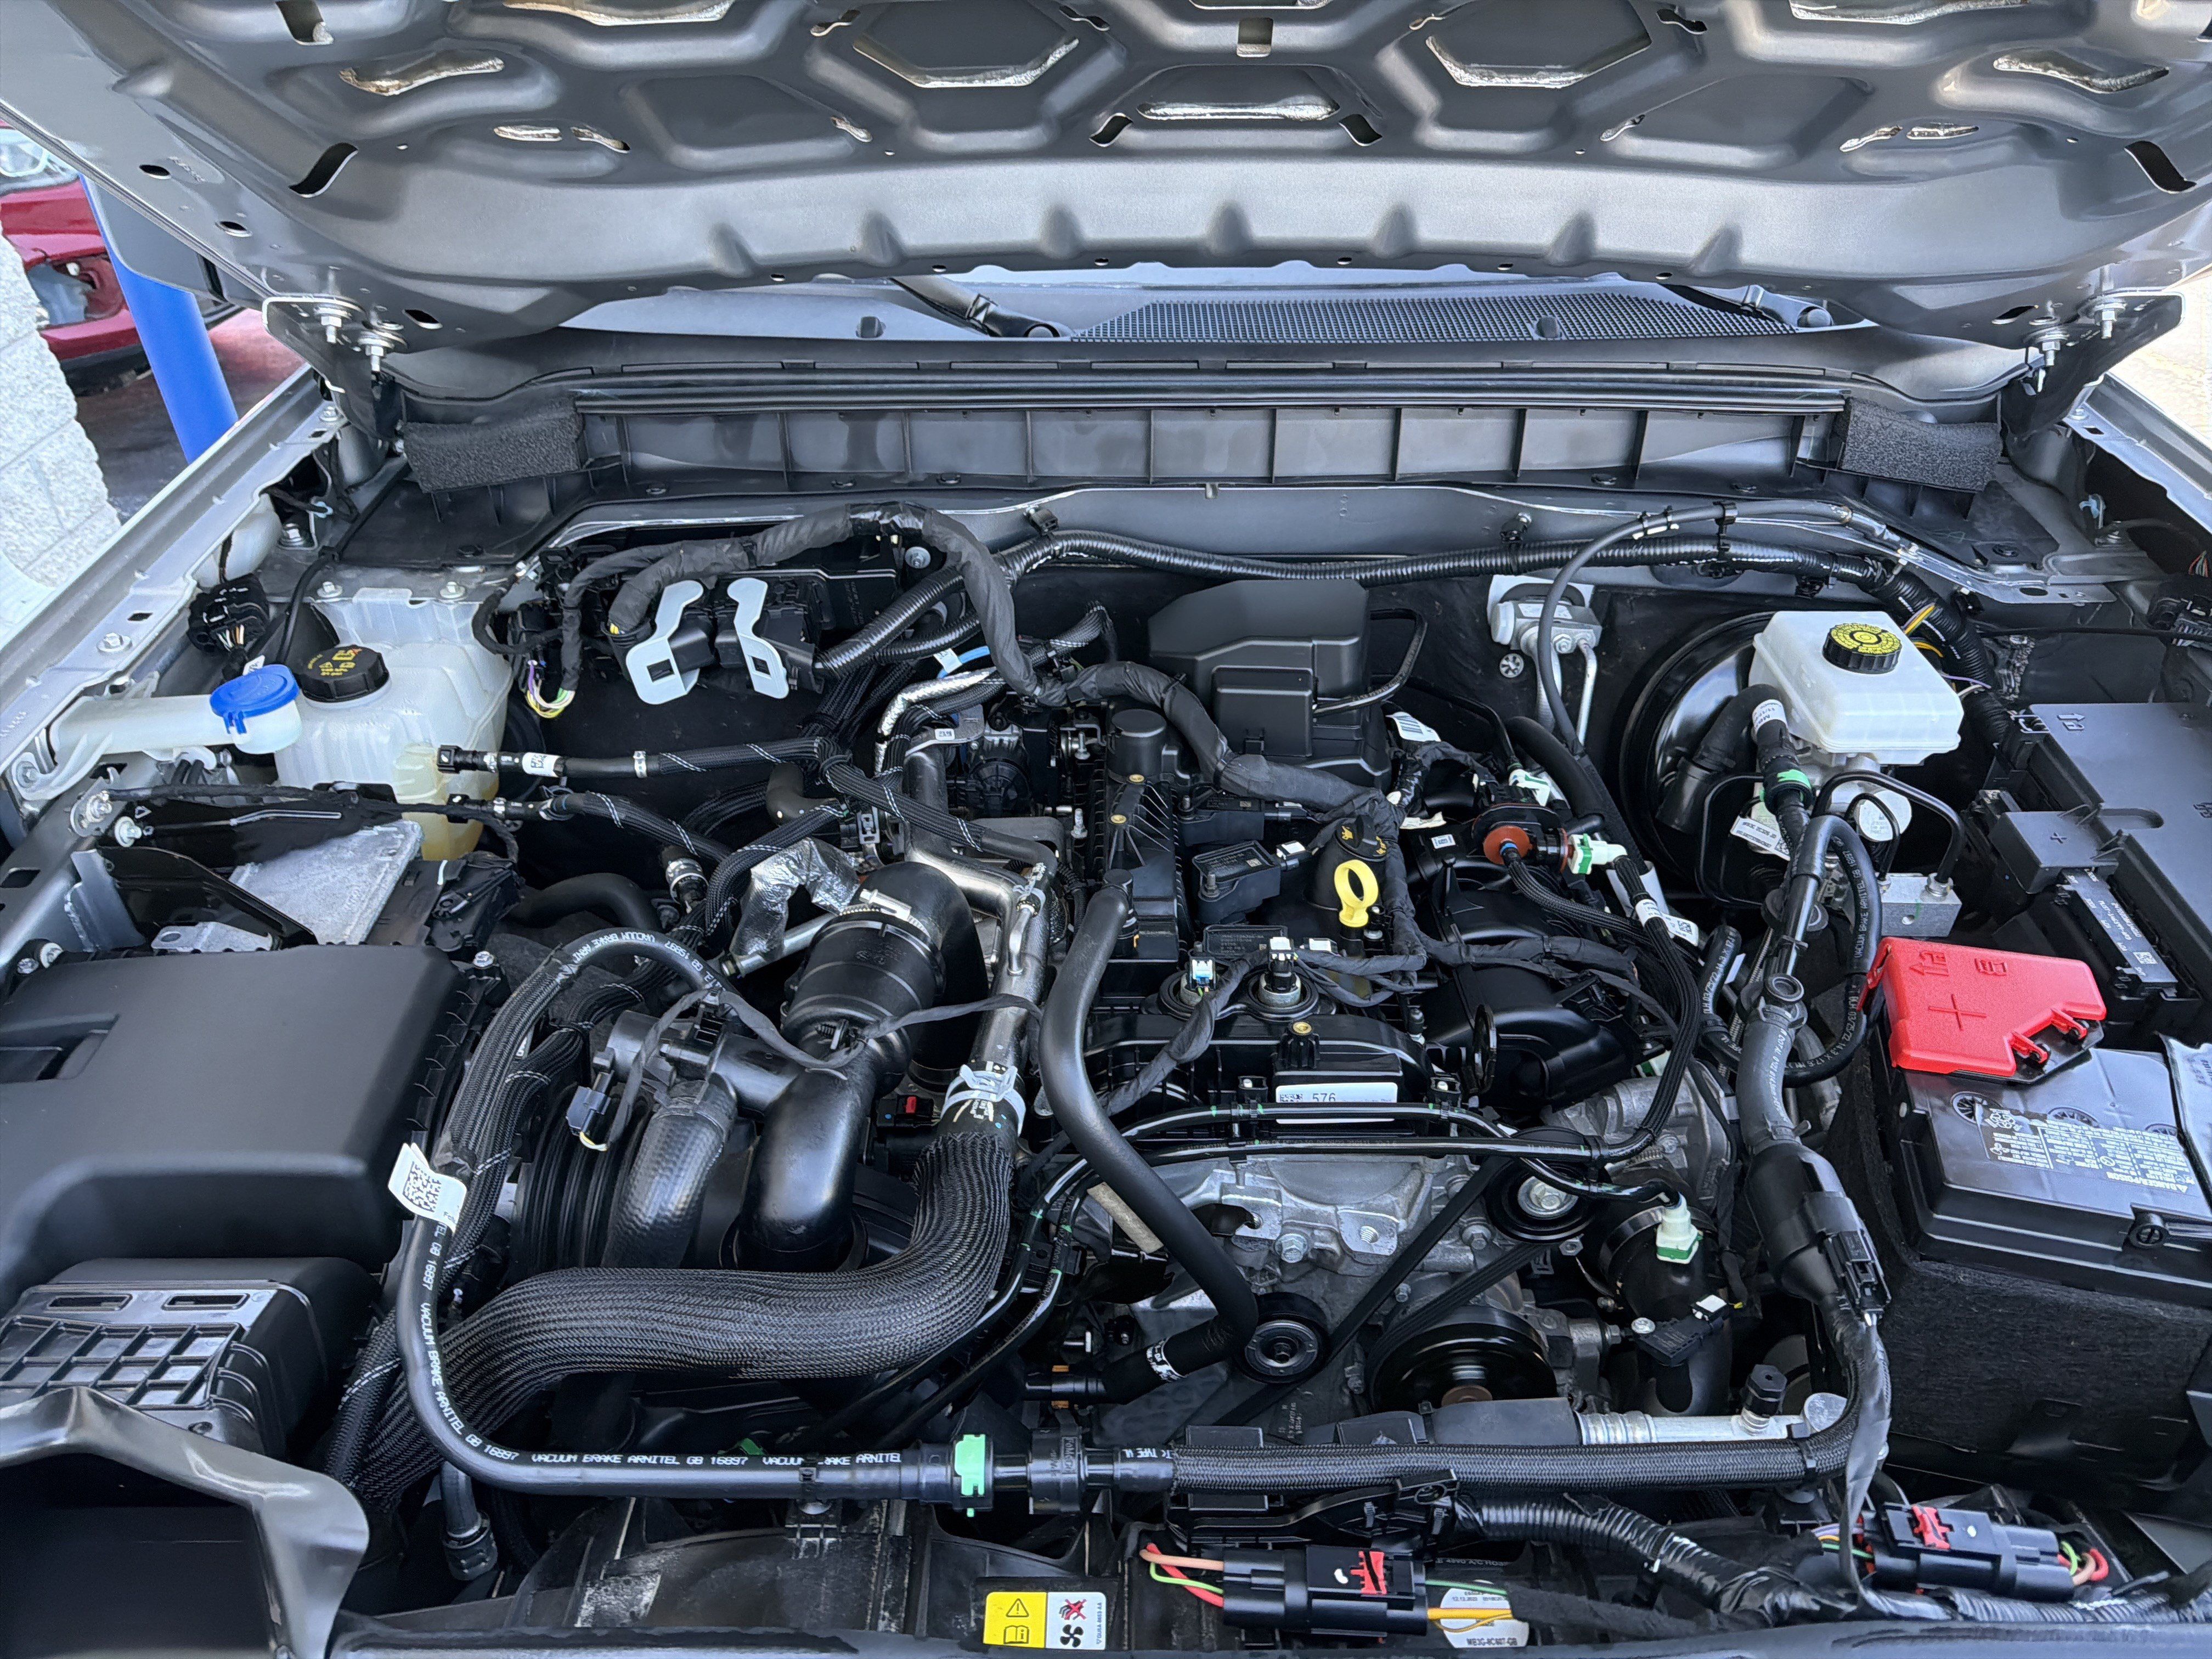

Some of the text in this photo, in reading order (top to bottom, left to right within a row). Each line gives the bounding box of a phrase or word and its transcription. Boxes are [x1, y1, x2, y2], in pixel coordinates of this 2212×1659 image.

[1859, 911, 1869, 932] BRAKE
[591, 933, 619, 949] BRAKE
[620, 932, 656, 943] VACUUM
[1854, 933, 1866, 958] VACUUM
[1312, 1093, 1336, 1103] 576
[420, 1302, 436, 1345] VACUUM
[428, 1350, 443, 1387] BRAKE
[435, 1391, 465, 1435] ARNITEL
[484, 1444, 520, 1461] 16897
[531, 1454, 578, 1463] VACUUM
[582, 1454, 623, 1464] BRAKE
[627, 1455, 680, 1465] ARNITEL
[710, 1457, 749, 1465] 16897
[817, 1457, 851, 1465] RAKE
